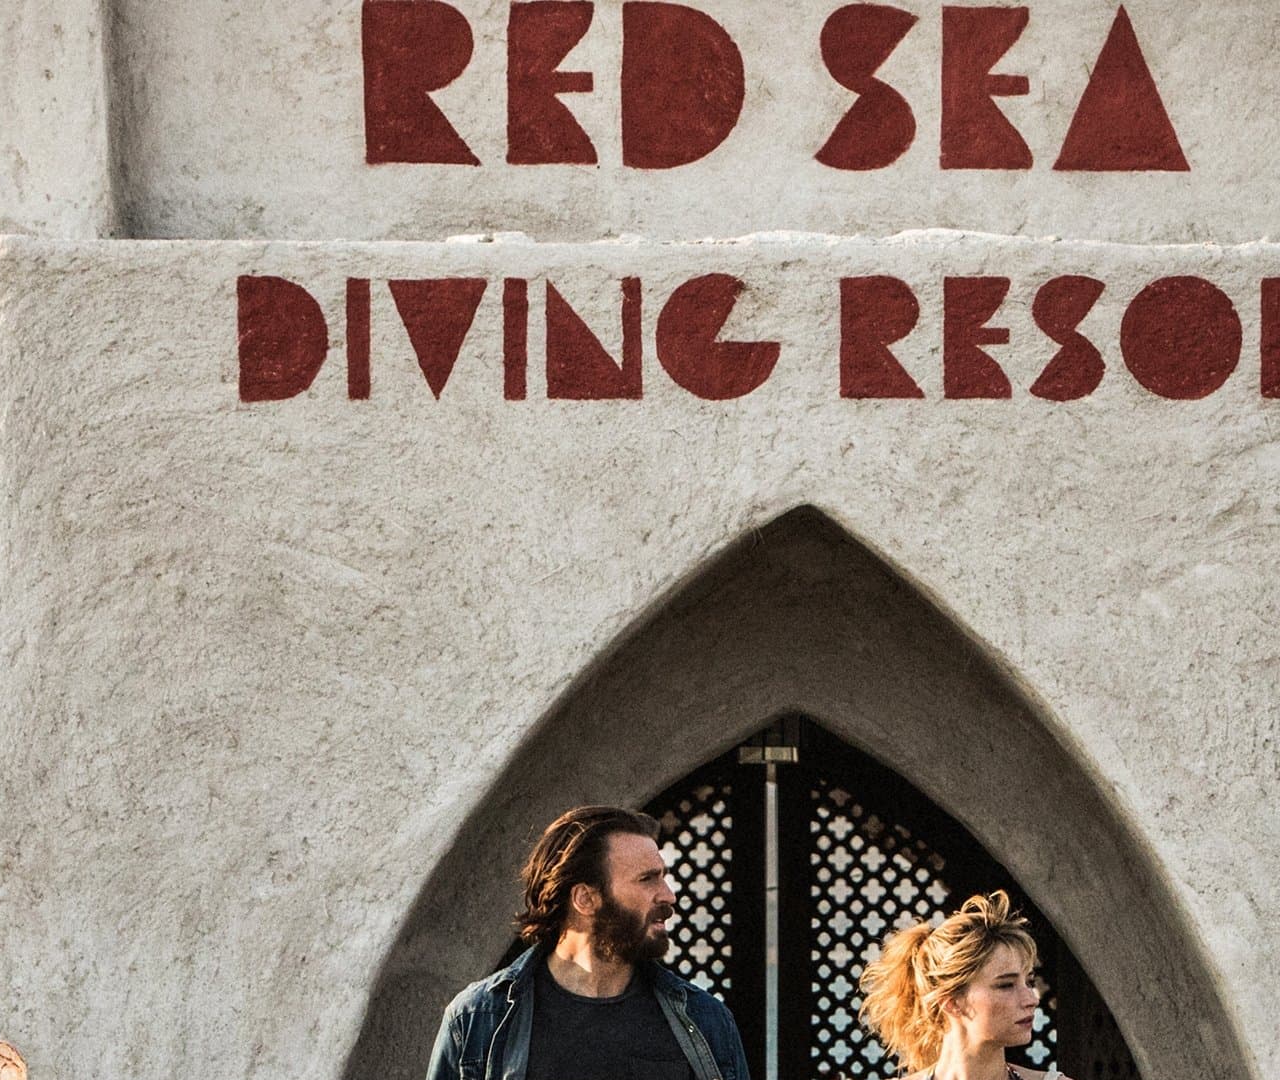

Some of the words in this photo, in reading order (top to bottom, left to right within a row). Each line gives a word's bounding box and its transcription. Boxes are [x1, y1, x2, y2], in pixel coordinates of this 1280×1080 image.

[361, 0, 746, 169] RED
[814, 3, 1191, 171] SEA
[237, 274, 781, 402] DIVING
